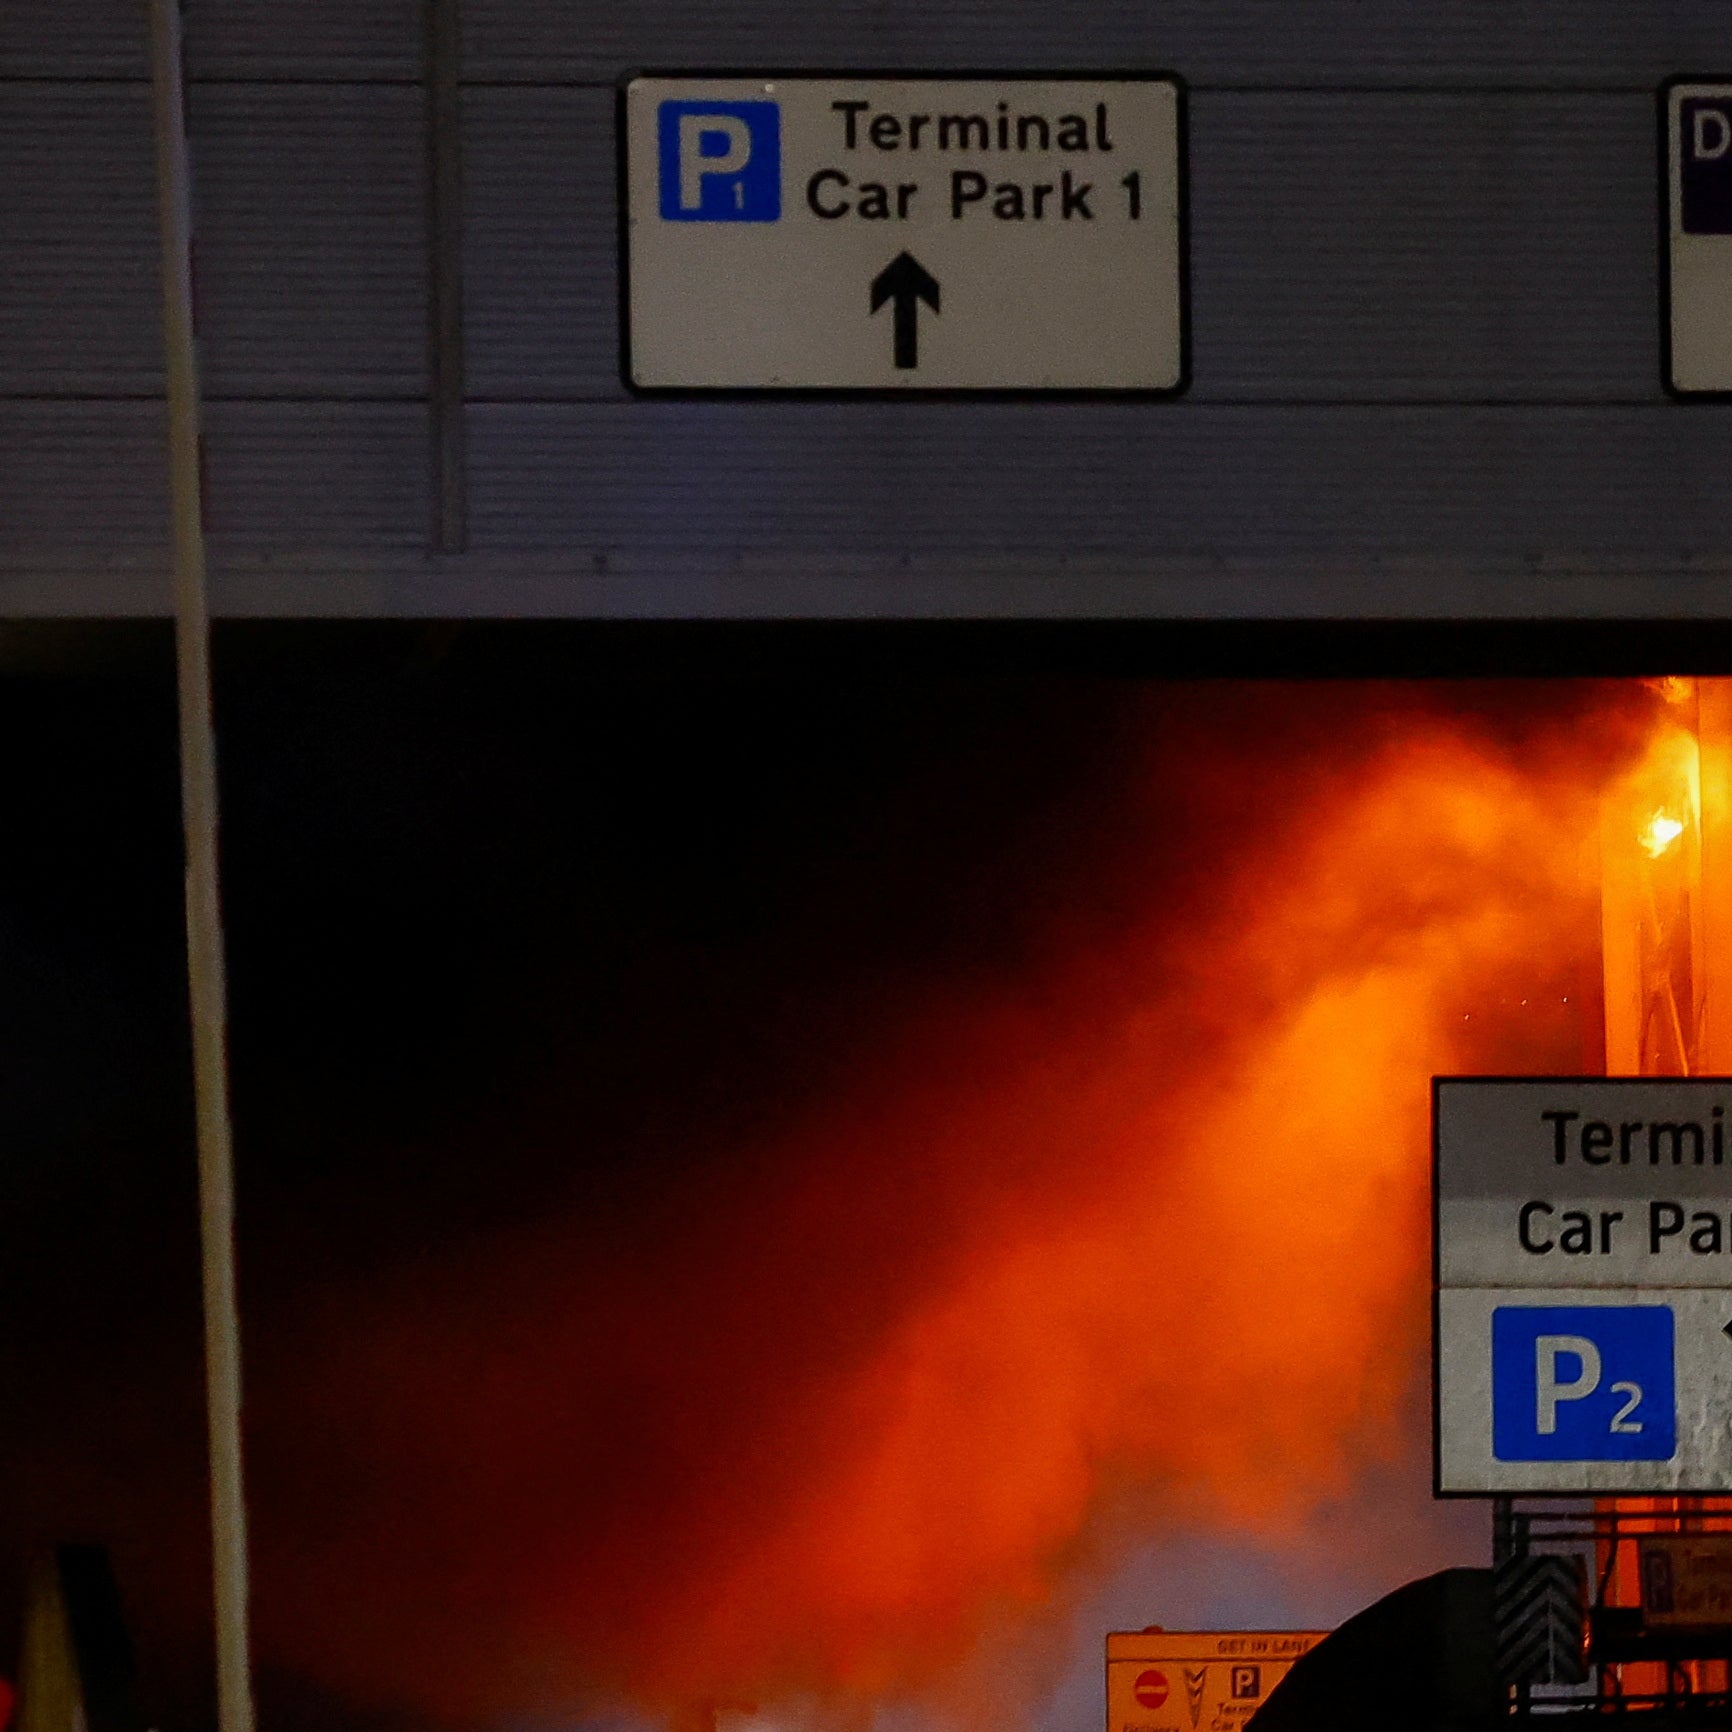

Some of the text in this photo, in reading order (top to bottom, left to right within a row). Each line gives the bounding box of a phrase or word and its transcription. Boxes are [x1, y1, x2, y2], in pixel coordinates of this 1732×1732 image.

[831, 100, 1113, 151] Terminal
[806, 169, 1142, 220] Car Park 1
[1518, 1201, 1623, 1255] Car
